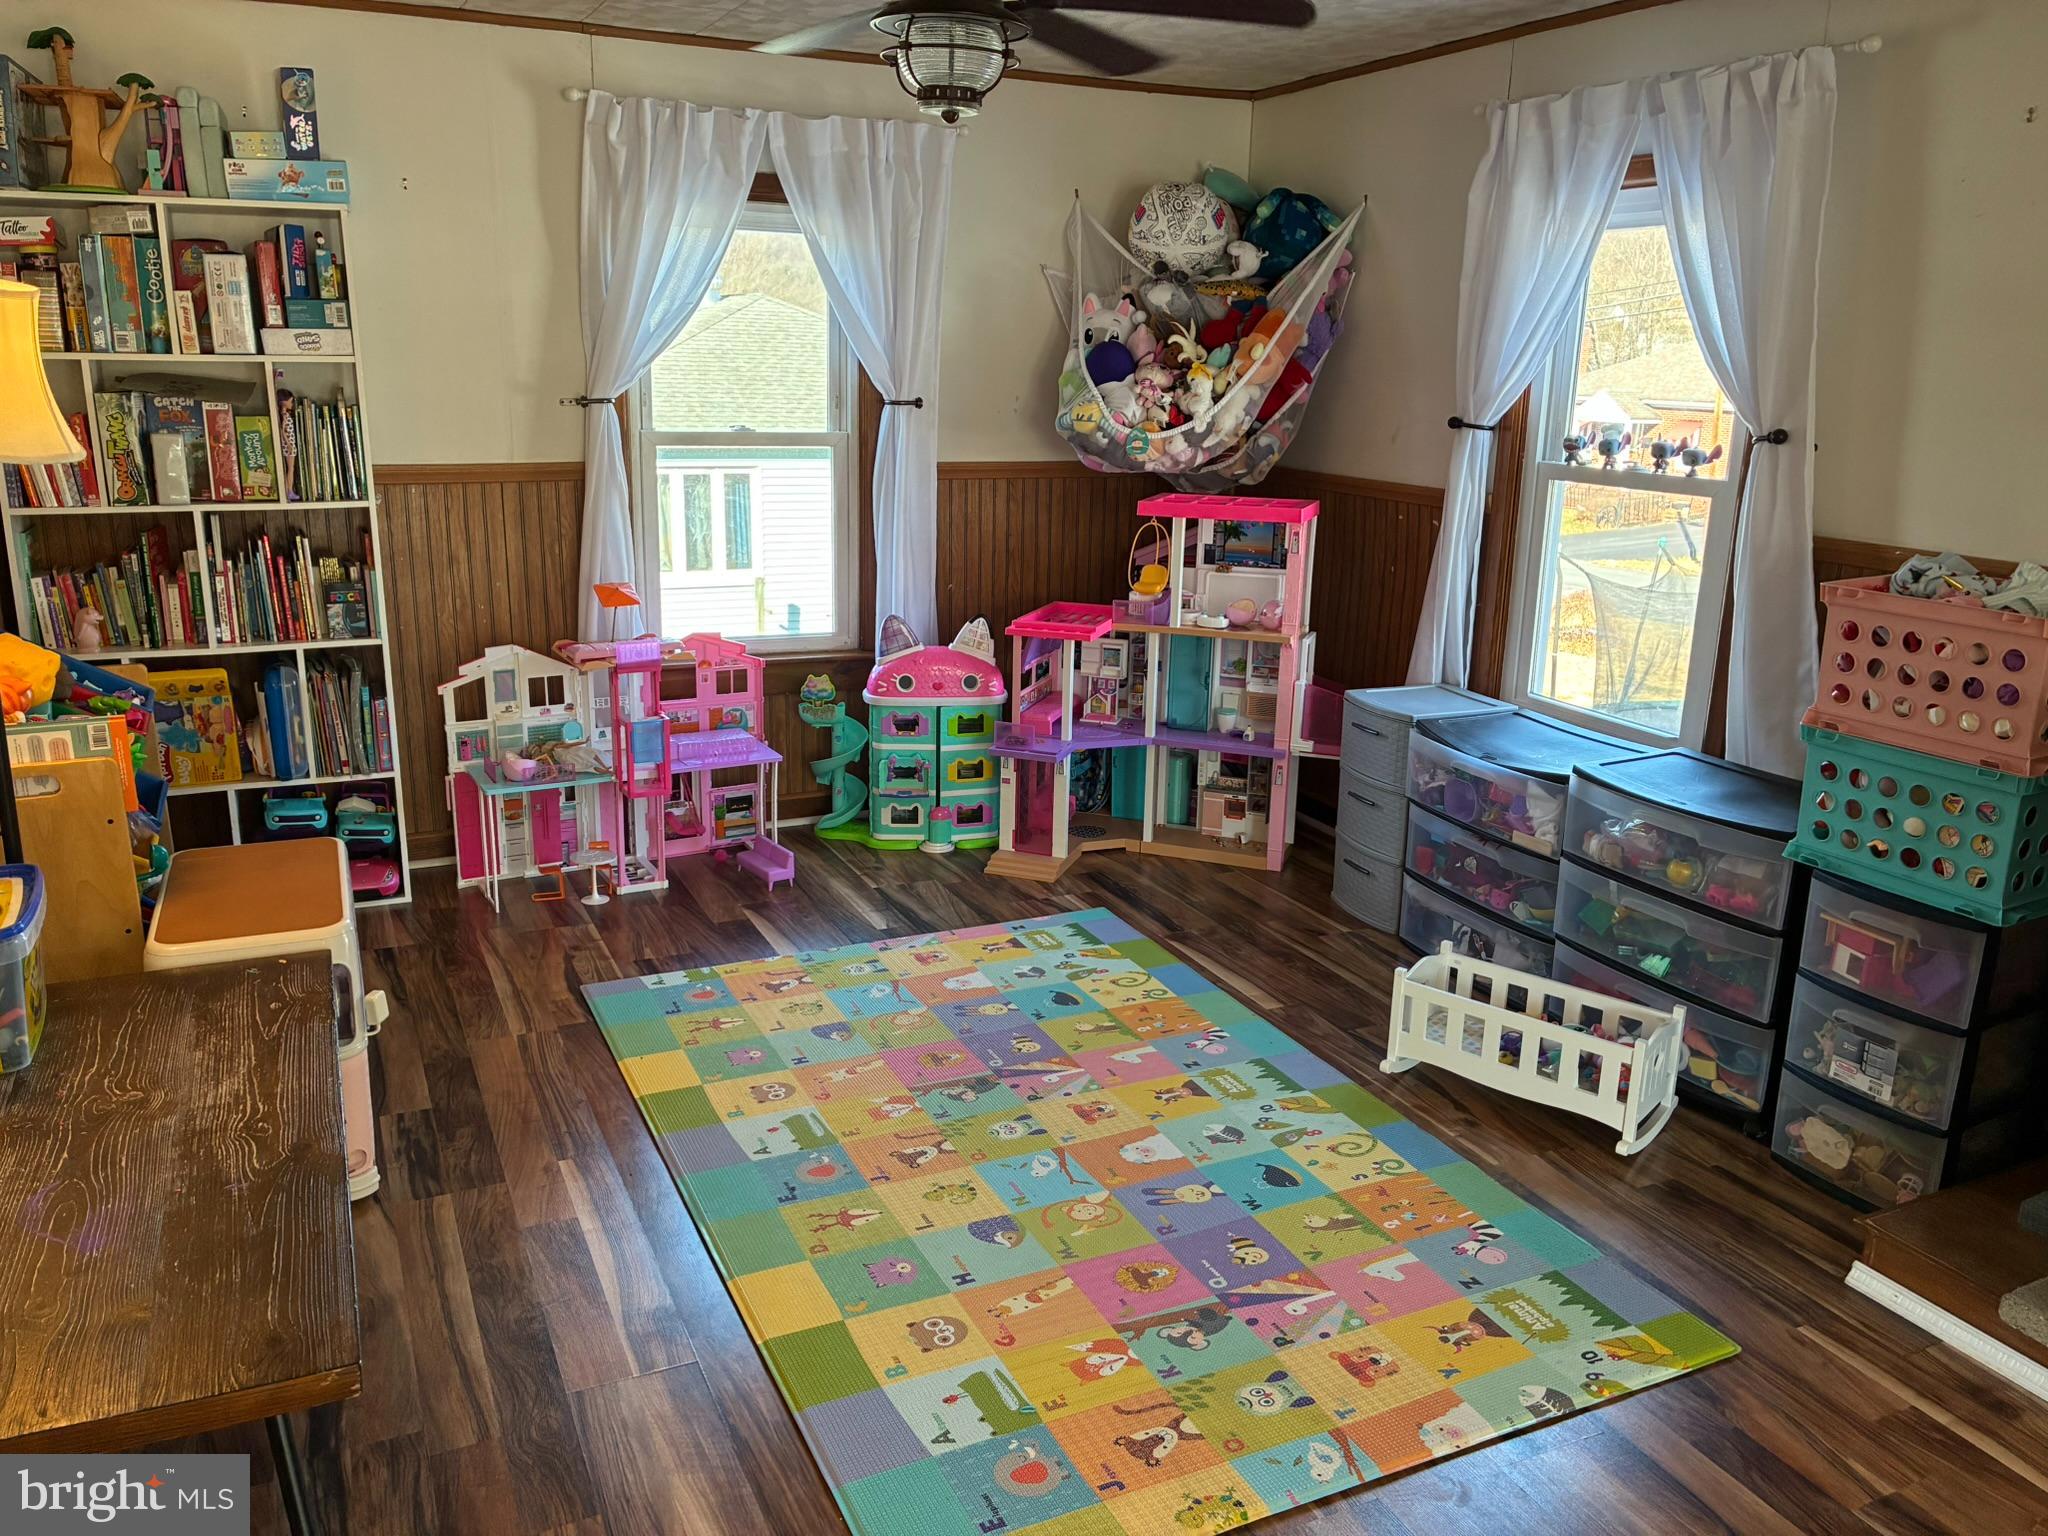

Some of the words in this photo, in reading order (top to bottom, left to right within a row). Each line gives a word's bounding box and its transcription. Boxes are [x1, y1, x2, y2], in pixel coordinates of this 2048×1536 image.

[144, 248, 164, 303] Cootie
[153, 397, 194, 407] CATCH
[243, 432, 257, 468] Monkey
[250, 432, 266, 467] Around
[1578, 1349, 1605, 1364] 10
